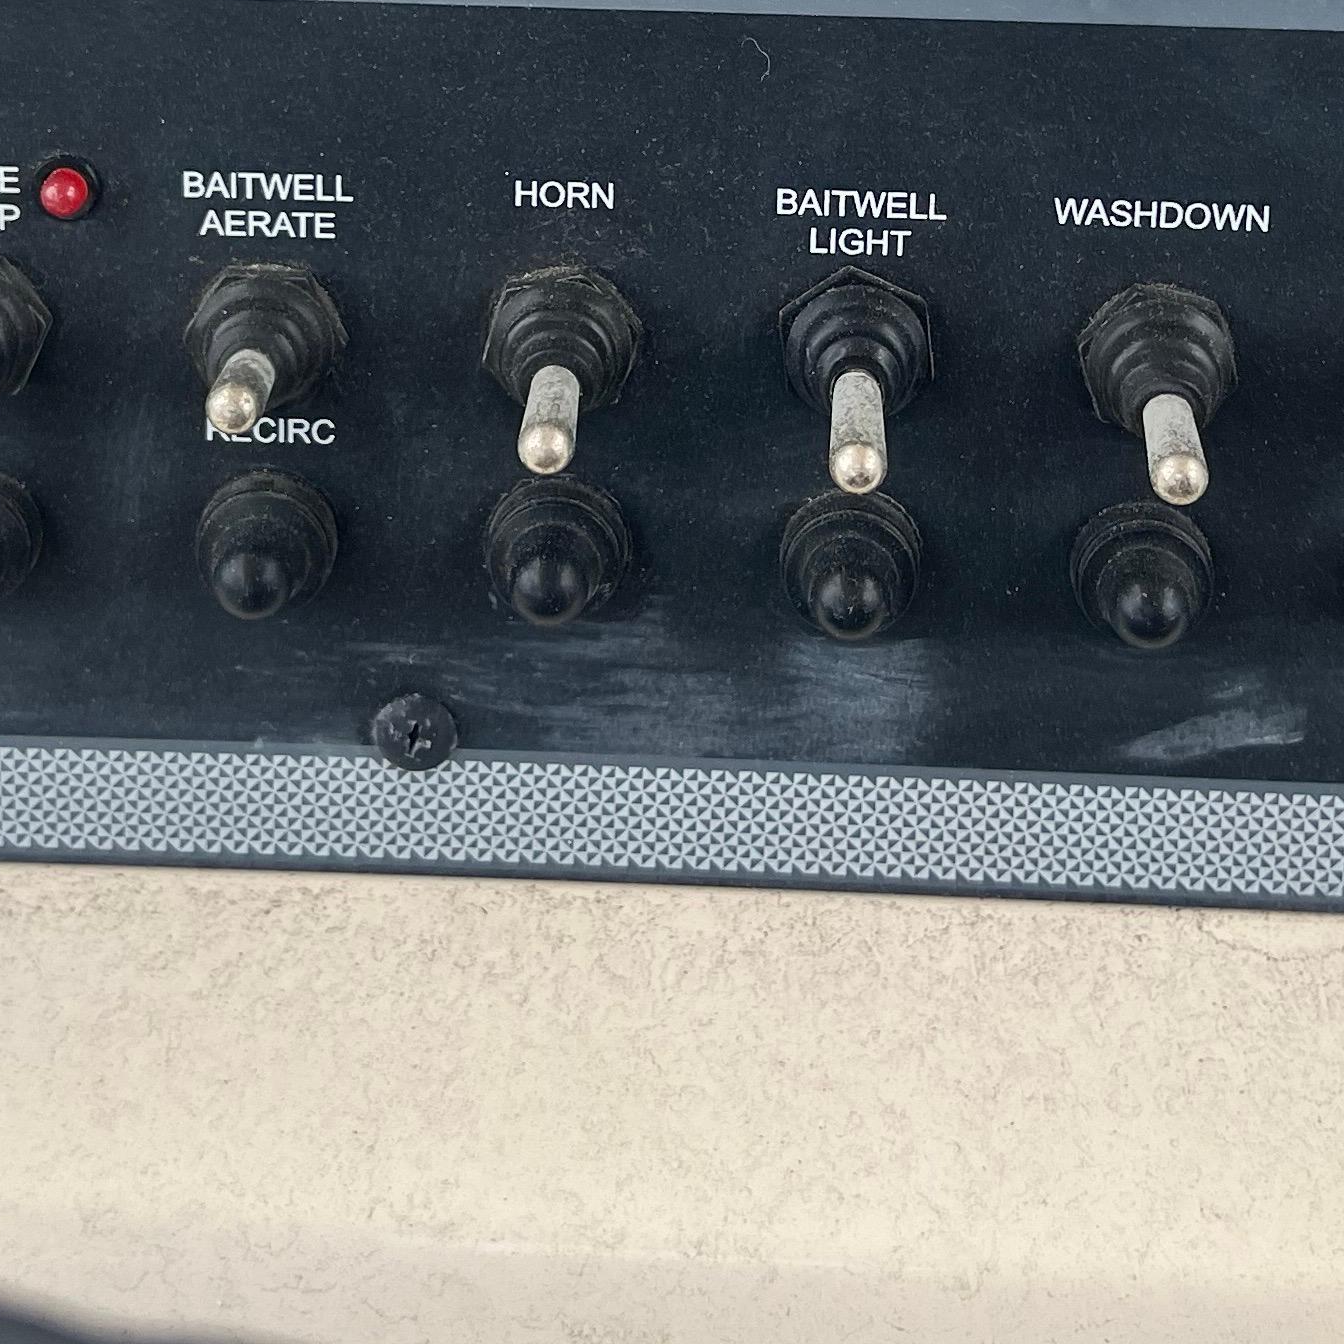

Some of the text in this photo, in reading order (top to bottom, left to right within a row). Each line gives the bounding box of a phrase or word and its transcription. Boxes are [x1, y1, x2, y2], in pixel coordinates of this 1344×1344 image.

[182, 170, 354, 202] BAITWELL
[514, 180, 615, 210] HORN
[776, 188, 948, 221] BAITWELL
[1054, 197, 1270, 233] WASHDOWN
[199, 209, 336, 239] AERATE
[809, 227, 912, 257] LIGHT
